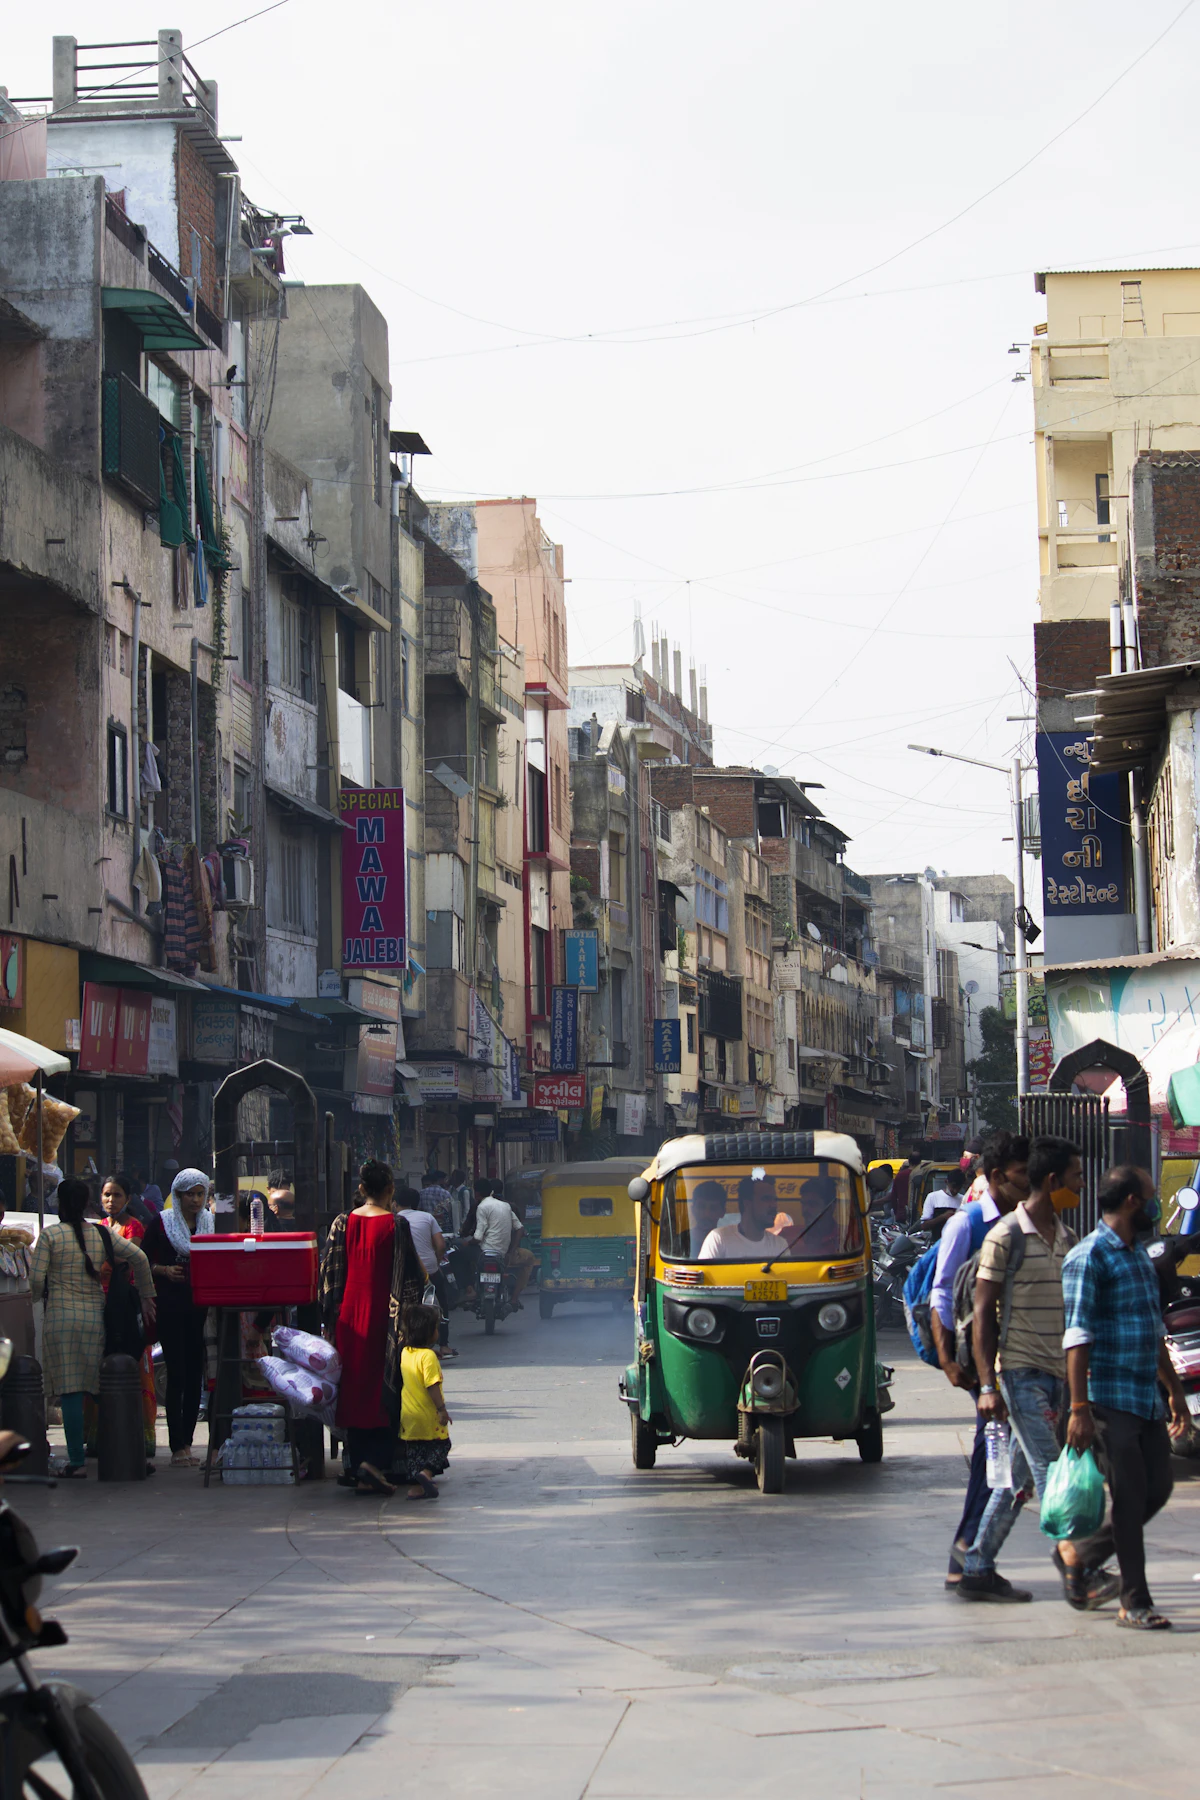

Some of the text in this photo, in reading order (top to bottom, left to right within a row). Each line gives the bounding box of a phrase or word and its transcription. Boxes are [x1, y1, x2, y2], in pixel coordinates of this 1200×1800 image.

[340, 792, 401, 810] SPECIAL
[355, 816, 388, 933] MAWA
[567, 930, 597, 938] HOTEL
[342, 937, 405, 965] JALEBI
[578, 938, 586, 986] SAHARA
[661, 1021, 673, 1061] KALAPI
[552, 1062, 575, 1070] (A/C)
[654, 1062, 680, 1072] SALON
[538, 1080, 582, 1097] જમીલ
[752, 1291, 780, 1300] A2576
[760, 1323, 776, 1333] RE
